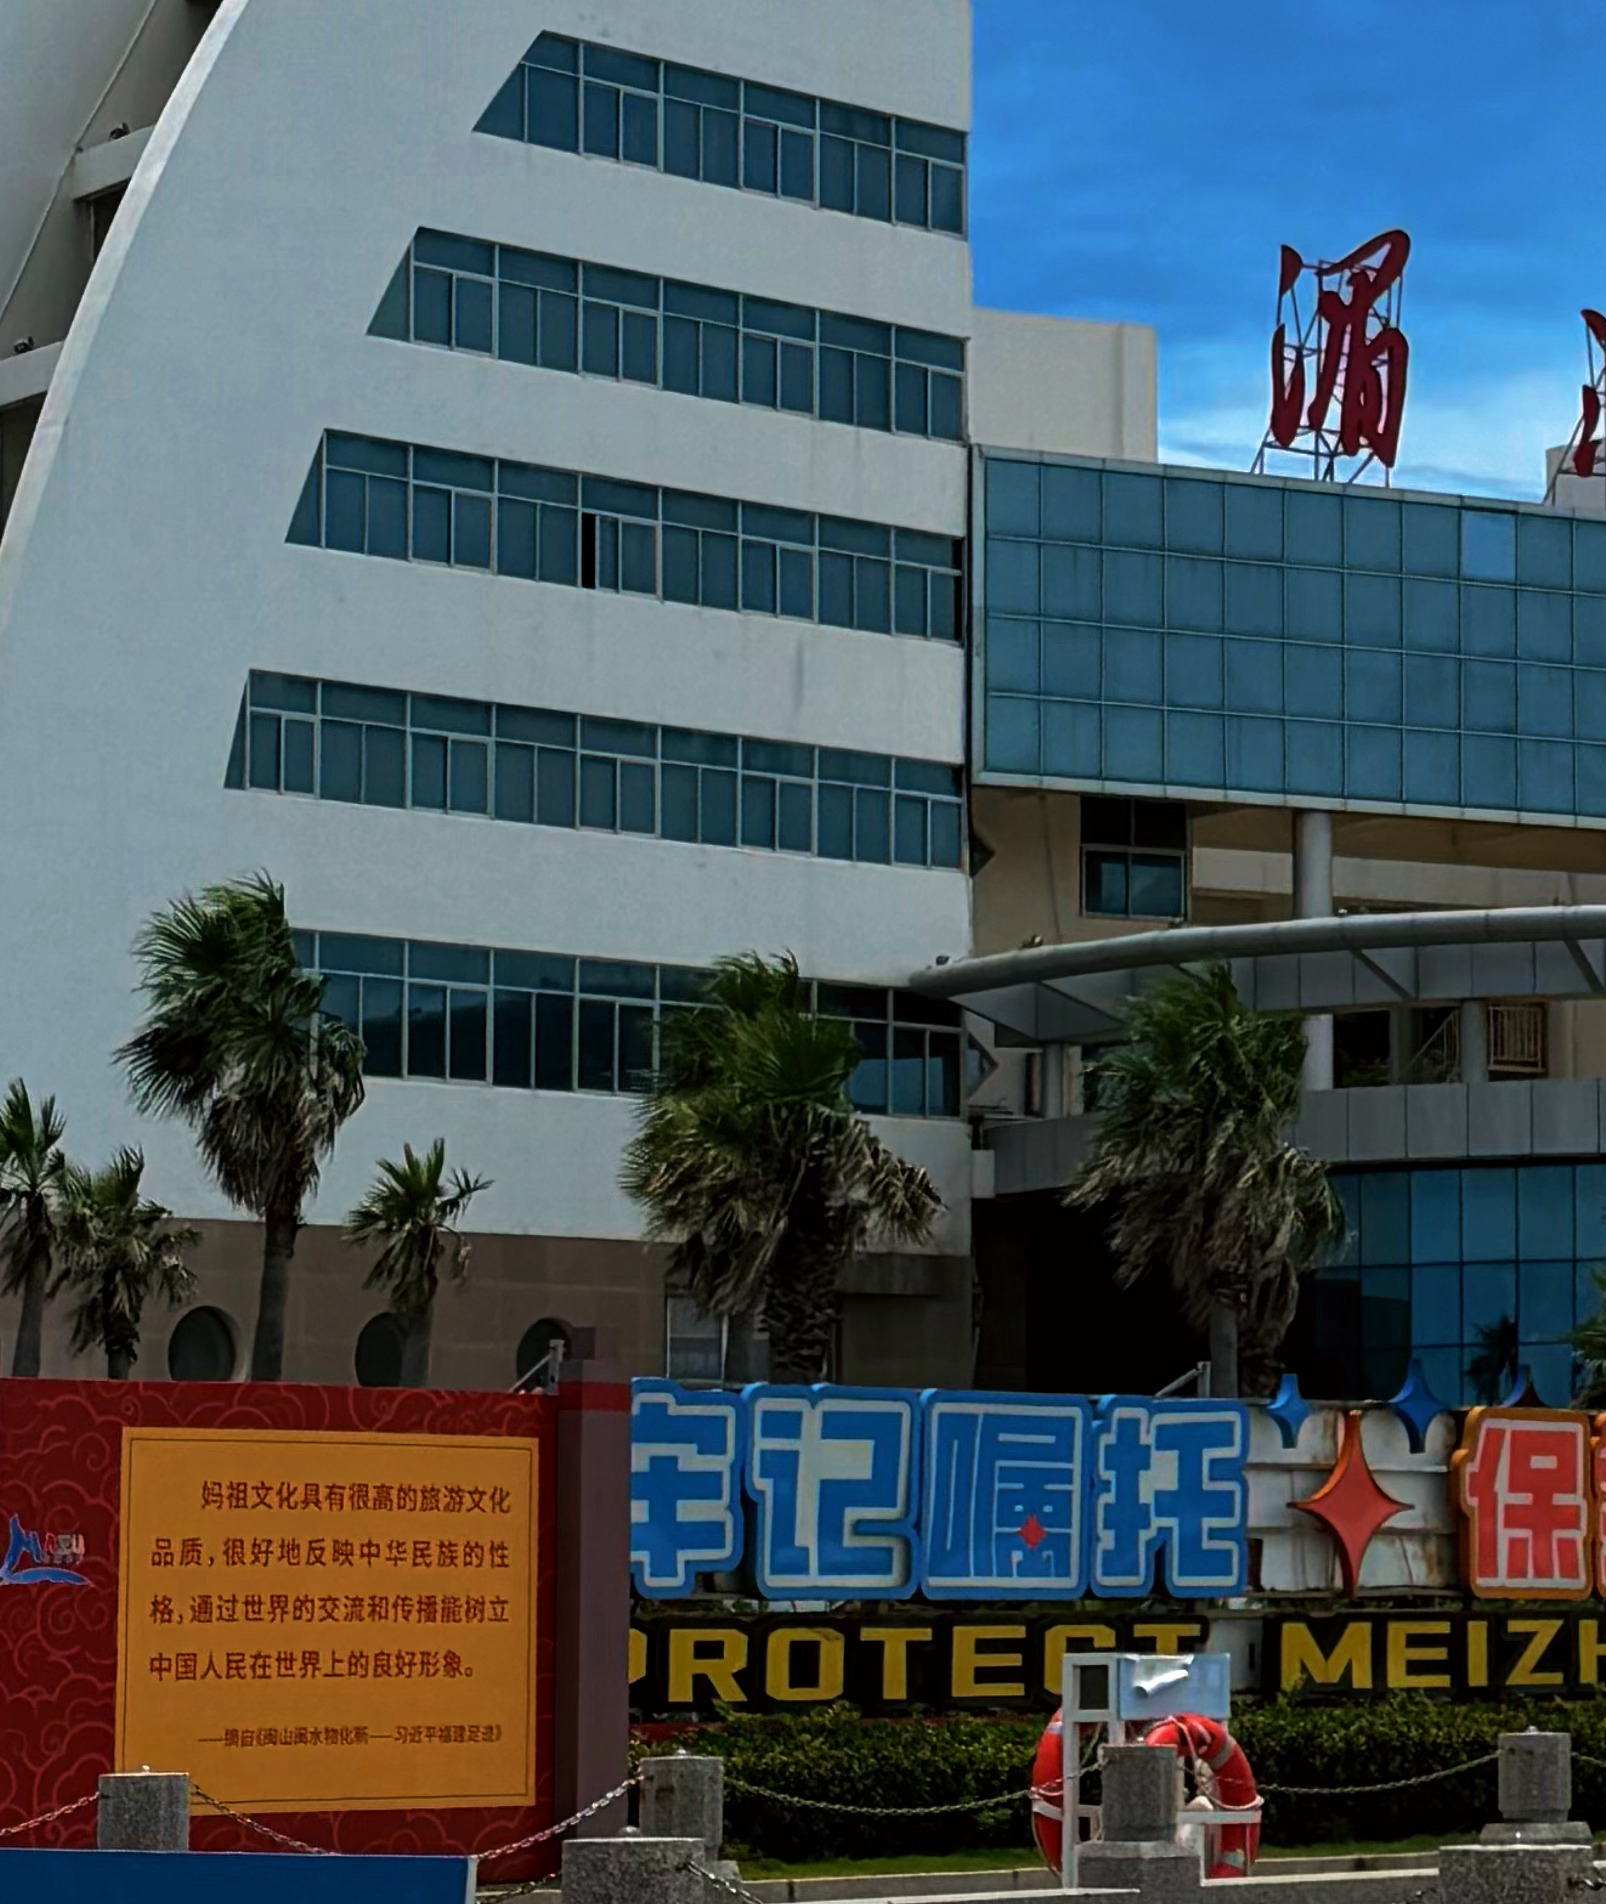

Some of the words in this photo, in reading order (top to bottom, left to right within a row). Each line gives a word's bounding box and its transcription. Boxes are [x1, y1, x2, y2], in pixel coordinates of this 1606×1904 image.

[201, 1480, 511, 1514] 妈祖文化具有很高的旅游文化
[631, 1377, 1250, 1600] 牢记嘱托
[150, 1649, 473, 1681] 中国人民在世界上的良好形象。
